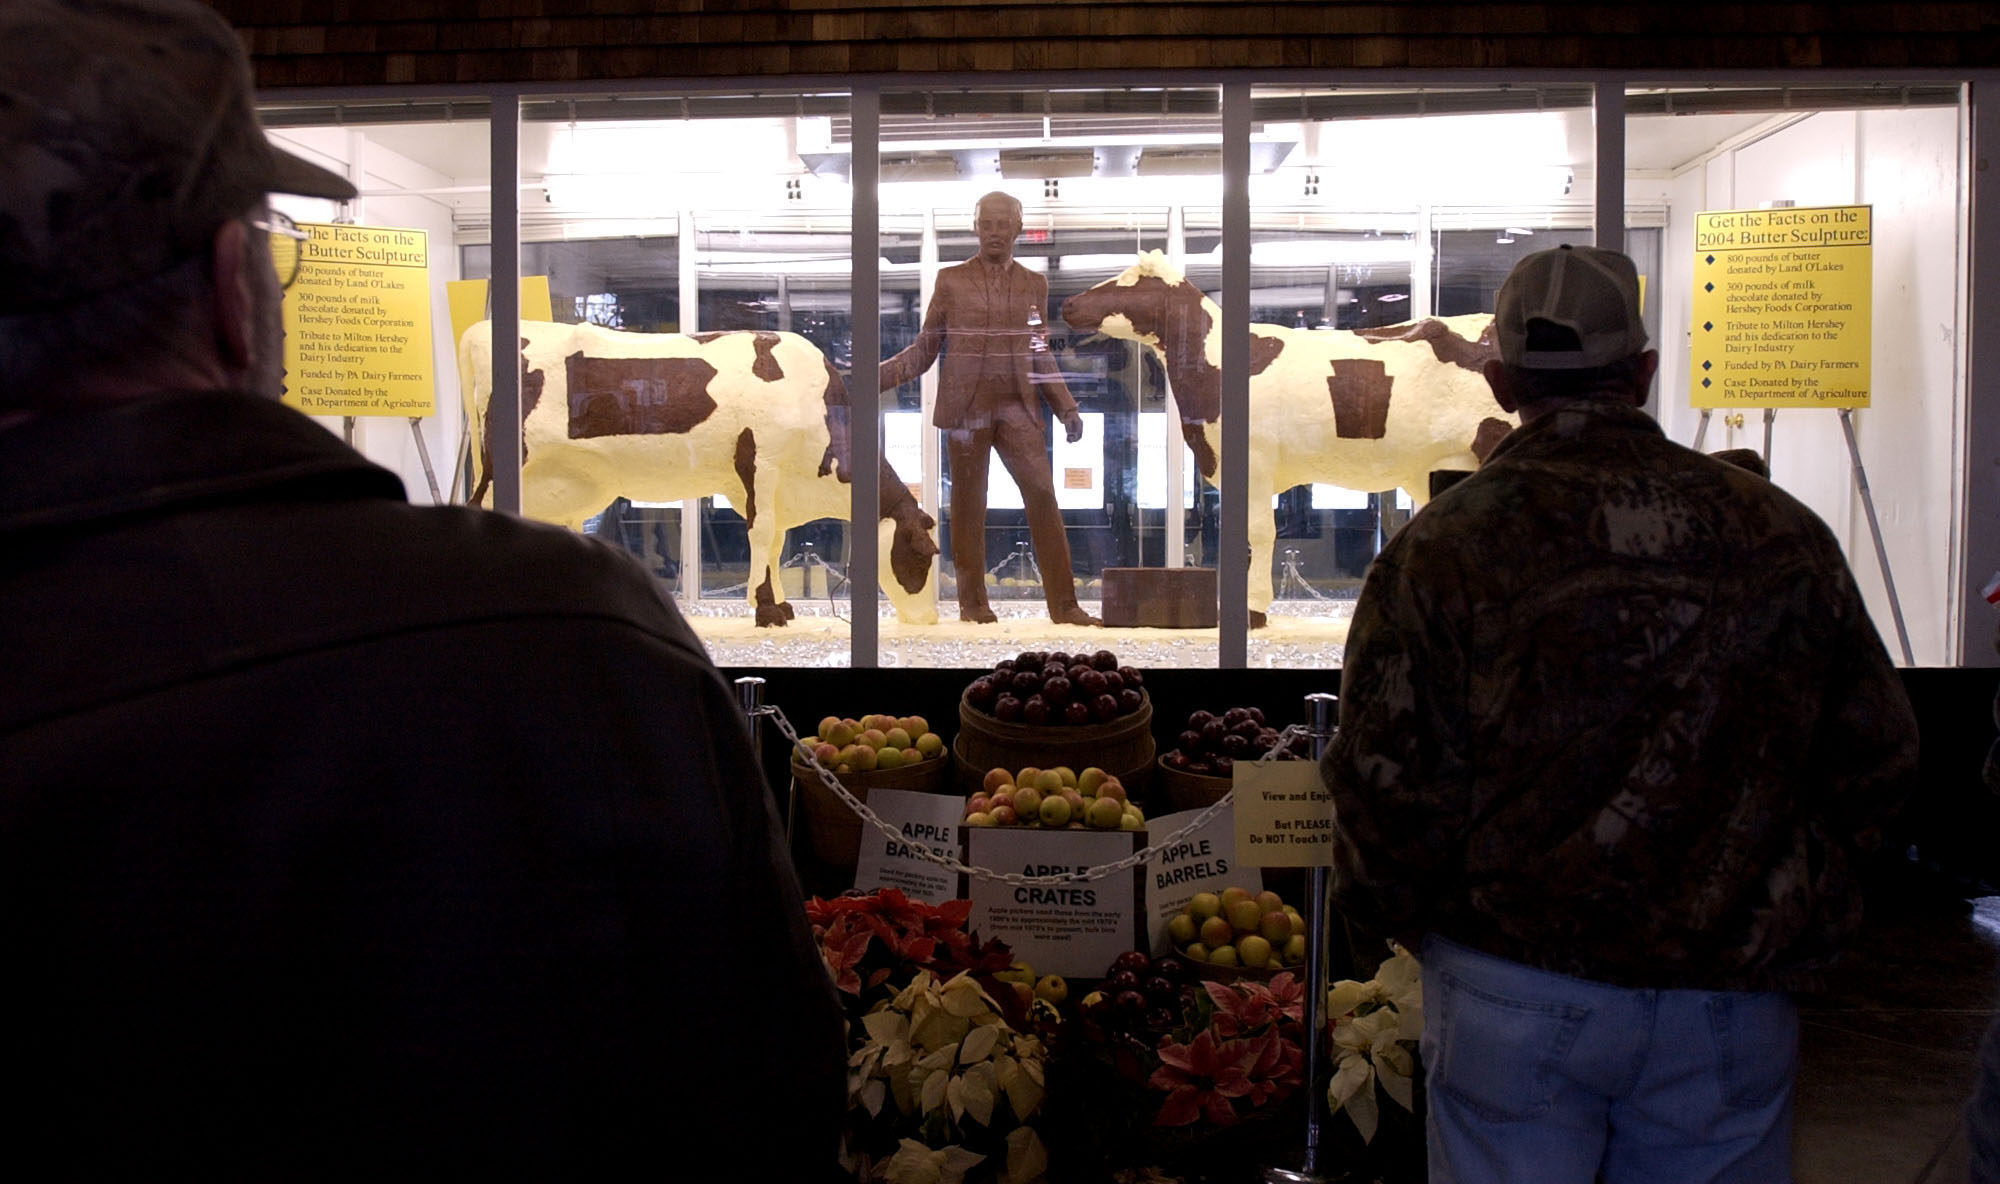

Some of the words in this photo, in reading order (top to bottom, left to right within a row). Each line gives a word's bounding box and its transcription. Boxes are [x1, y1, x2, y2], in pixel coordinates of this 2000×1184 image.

[1709, 216, 1735, 229] Get
[1740, 214, 1762, 226] the
[1768, 212, 1806, 226] Facts
[1811, 213, 1828, 223] on
[1835, 210, 1857, 222] the
[308, 227, 328, 240] the
[334, 229, 369, 242] Facts
[374, 234, 389, 244] on
[395, 233, 414, 245] the
[1700, 233, 1735, 246] 2004
[1740, 232, 1787, 244] Butter
[1791, 229, 1868, 244] Sculpture:
[310, 244, 352, 258] Butter
[356, 247, 424, 264] Sculpture:
[1746, 253, 1778, 265] pounds
[1781, 253, 1792, 261] of
[1793, 252, 1820, 261] butter
[316, 268, 345, 277] pounds
[349, 268, 358, 276] of
[359, 269, 384, 278] butter
[1727, 266, 1762, 274] donated
[1766, 265, 1776, 274] by
[1779, 263, 1802, 272] Land
[1806, 262, 1844, 272] O'Lakes
[298, 276, 332, 286] donated
[334, 278, 344, 288] by
[347, 280, 368, 288] Land
[371, 280, 404, 289] O'Lakes
[1727, 282, 1743, 291] 300
[1745, 281, 1777, 292] pounds
[1781, 281, 1791, 289] of
[1793, 280, 1815, 288] milk
[298, 293, 313, 302] 300
[316, 294, 346, 303] pounds
[349, 295, 358, 303] of
[360, 296, 380, 304] milk
[1726, 293, 1768, 302] chocolate
[1771, 292, 1808, 301] donated
[1811, 291, 1822, 301] by
[298, 304, 338, 314] chocolate
[341, 306, 374, 314] donated
[376, 308, 386, 317] by
[1726, 304, 1762, 314] Hershey
[1765, 304, 1792, 312] Foods
[1795, 303, 1852, 313] Corporation
[299, 315, 333, 325] Hershey
[336, 317, 361, 325] Foods
[363, 318, 414, 328] Corporation
[1727, 322, 1758, 330] Tribute
[1760, 322, 1769, 330] to
[1772, 321, 1804, 329] Milton
[1808, 320, 1845, 330] Hershey
[300, 331, 330, 340] Tribute
[344, 333, 372, 342] Milton
[376, 334, 408, 343] Hershey
[1725, 333, 1741, 342] and
[1761, 332, 1808, 340] dedication
[1812, 332, 1821, 340] to
[1824, 331, 1838, 340] the
[300, 342, 315, 350] and
[318, 343, 331, 351] his
[334, 344, 377, 353] dedication
[1725, 344, 1752, 355] Dairy
[1754, 343, 1795, 354] Industry
[300, 354, 325, 364] Dairy
[328, 354, 364, 364] Industry
[1725, 361, 1758, 370] Funded
[1761, 361, 1772, 371] by
[1774, 360, 1786, 369] PA
[1791, 360, 1818, 370] Dairy
[1820, 360, 1859, 368] Farmers
[300, 370, 332, 378] Funded
[335, 371, 345, 381] by
[347, 371, 358, 379] PA
[362, 372, 386, 381] Dairy
[388, 372, 422, 381] Farmers
[1724, 378, 1746, 387] Case
[1750, 378, 1788, 386] Donated
[1792, 378, 1802, 388] by
[1804, 378, 1818, 386] the
[301, 386, 322, 395] Case
[325, 387, 361, 396] Donated
[364, 388, 374, 397] by
[375, 388, 388, 396] the
[1724, 390, 1736, 398] PA
[1740, 389, 1795, 400] Department
[1798, 389, 1808, 397] of
[1812, 388, 1868, 400] Agriculture
[301, 398, 313, 406] PA
[316, 398, 368, 408] Department
[382, 399, 431, 409] Agriculture
[1262, 792, 1285, 800] View
[1289, 792, 1306, 800] and
[1310, 792, 1331, 802] Enjo
[1275, 820, 1291, 829] But
[1295, 820, 1331, 829] PLEASE
[902, 822, 949, 842] APPLE
[1250, 835, 1262, 843] Do
[1266, 834, 1285, 843] NOT
[1290, 834, 1318, 843] Touch
[1162, 840, 1211, 864] APPLE
[1023, 864, 1089, 882] APPLE
[1156, 859, 1228, 889] BARRELS
[1014, 888, 1096, 906] CRATES
